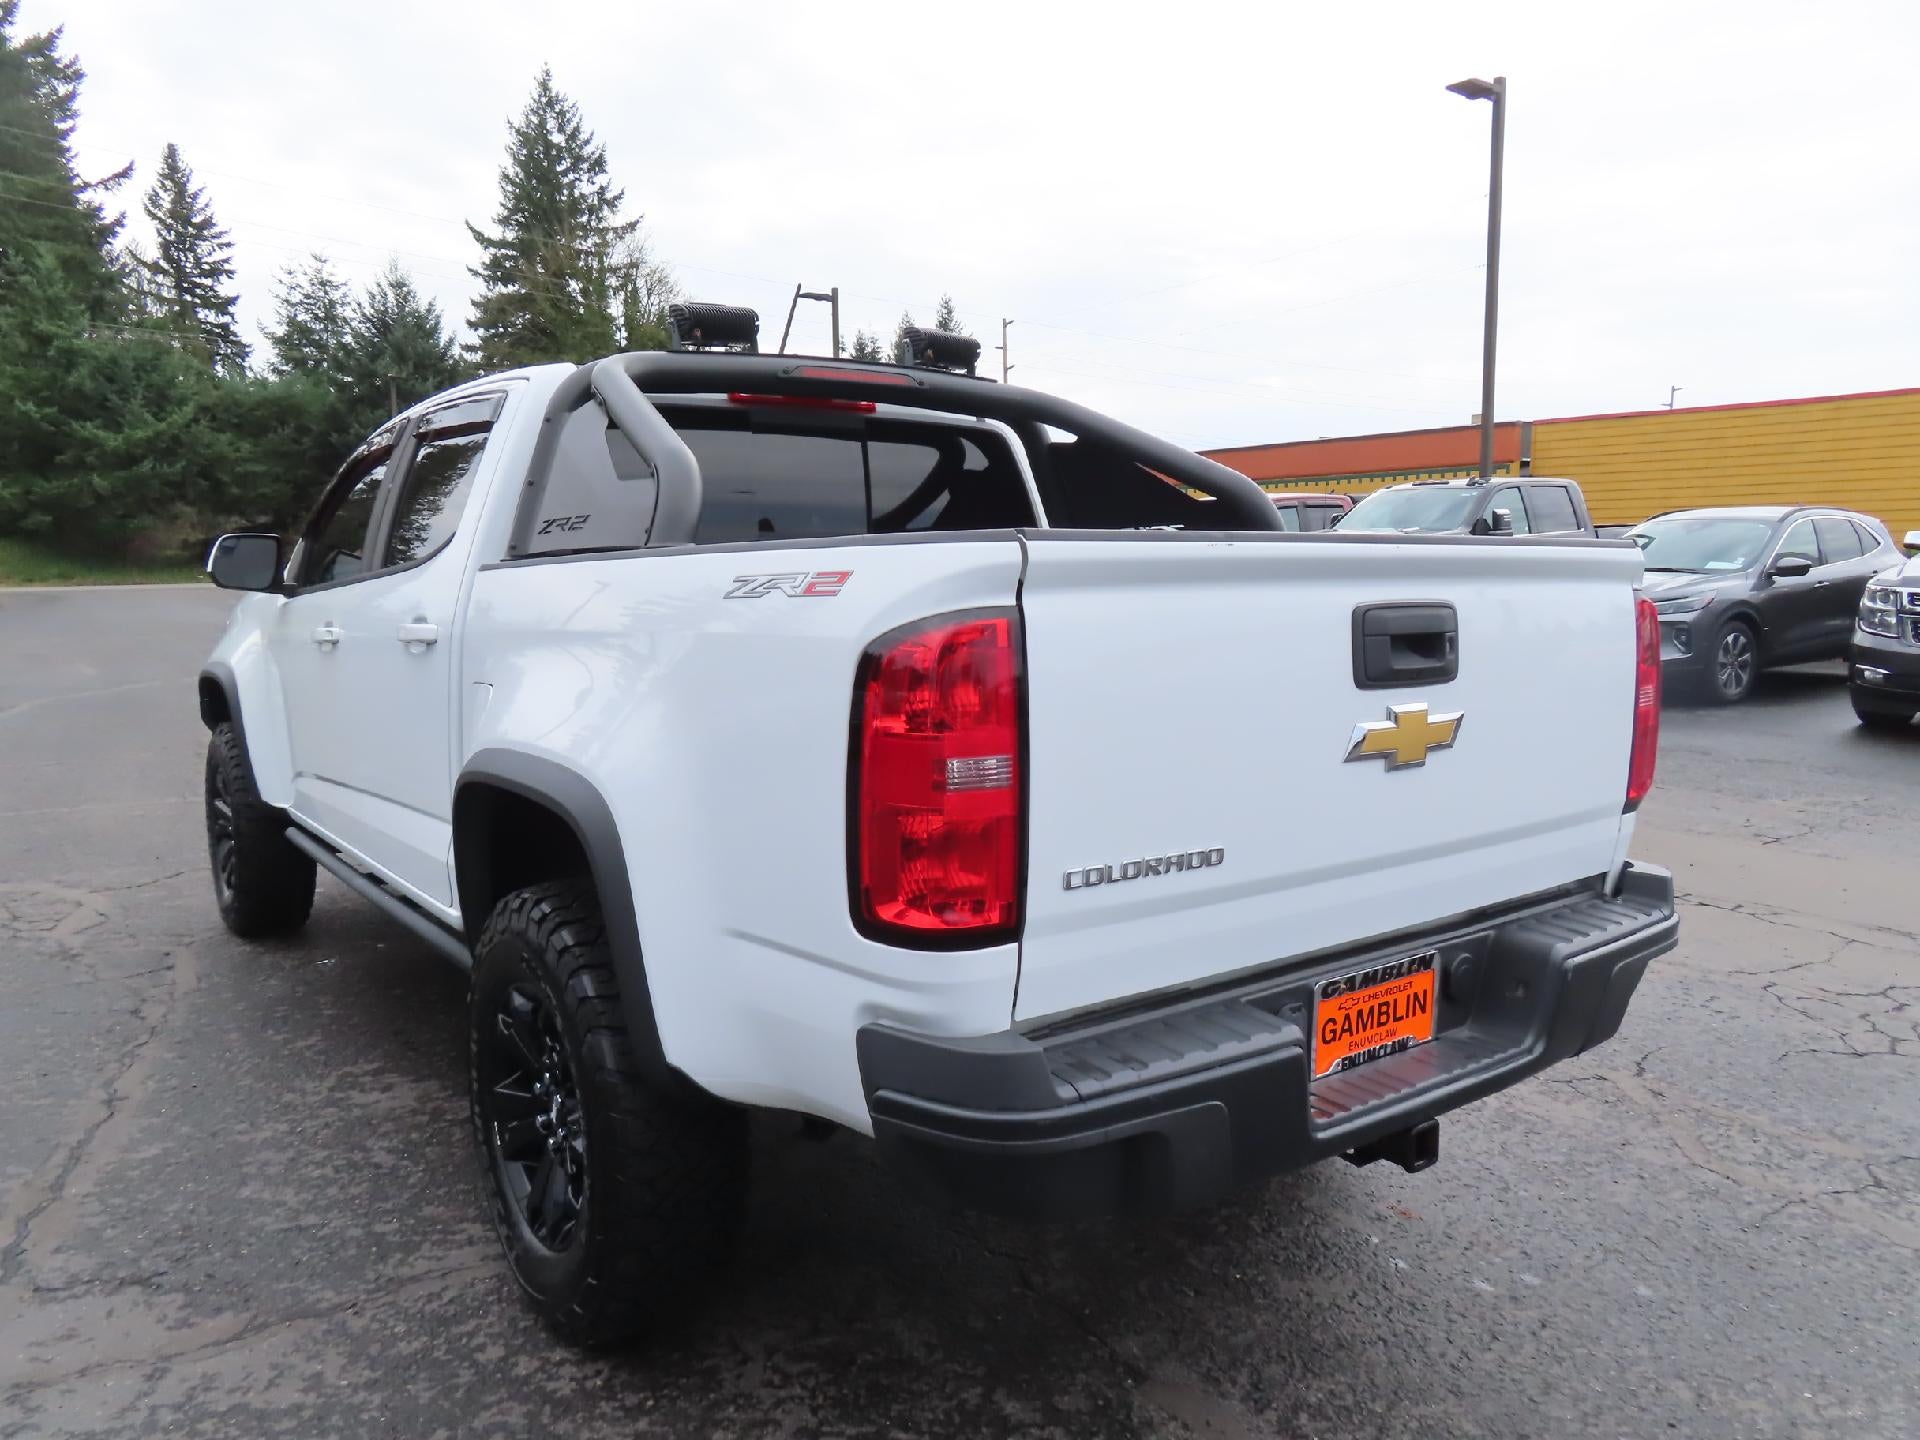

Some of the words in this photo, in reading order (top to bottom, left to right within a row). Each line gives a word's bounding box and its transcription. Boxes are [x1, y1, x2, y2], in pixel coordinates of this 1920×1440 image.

[538, 514, 590, 535] ZR2
[723, 570, 854, 599] ZR2
[1063, 846, 1225, 890] COLORADO
[1362, 981, 1414, 1003] CHEVROLET
[1321, 989, 1428, 1045] GAMBLIN
[1348, 1028, 1398, 1051] ENUMCLAW
